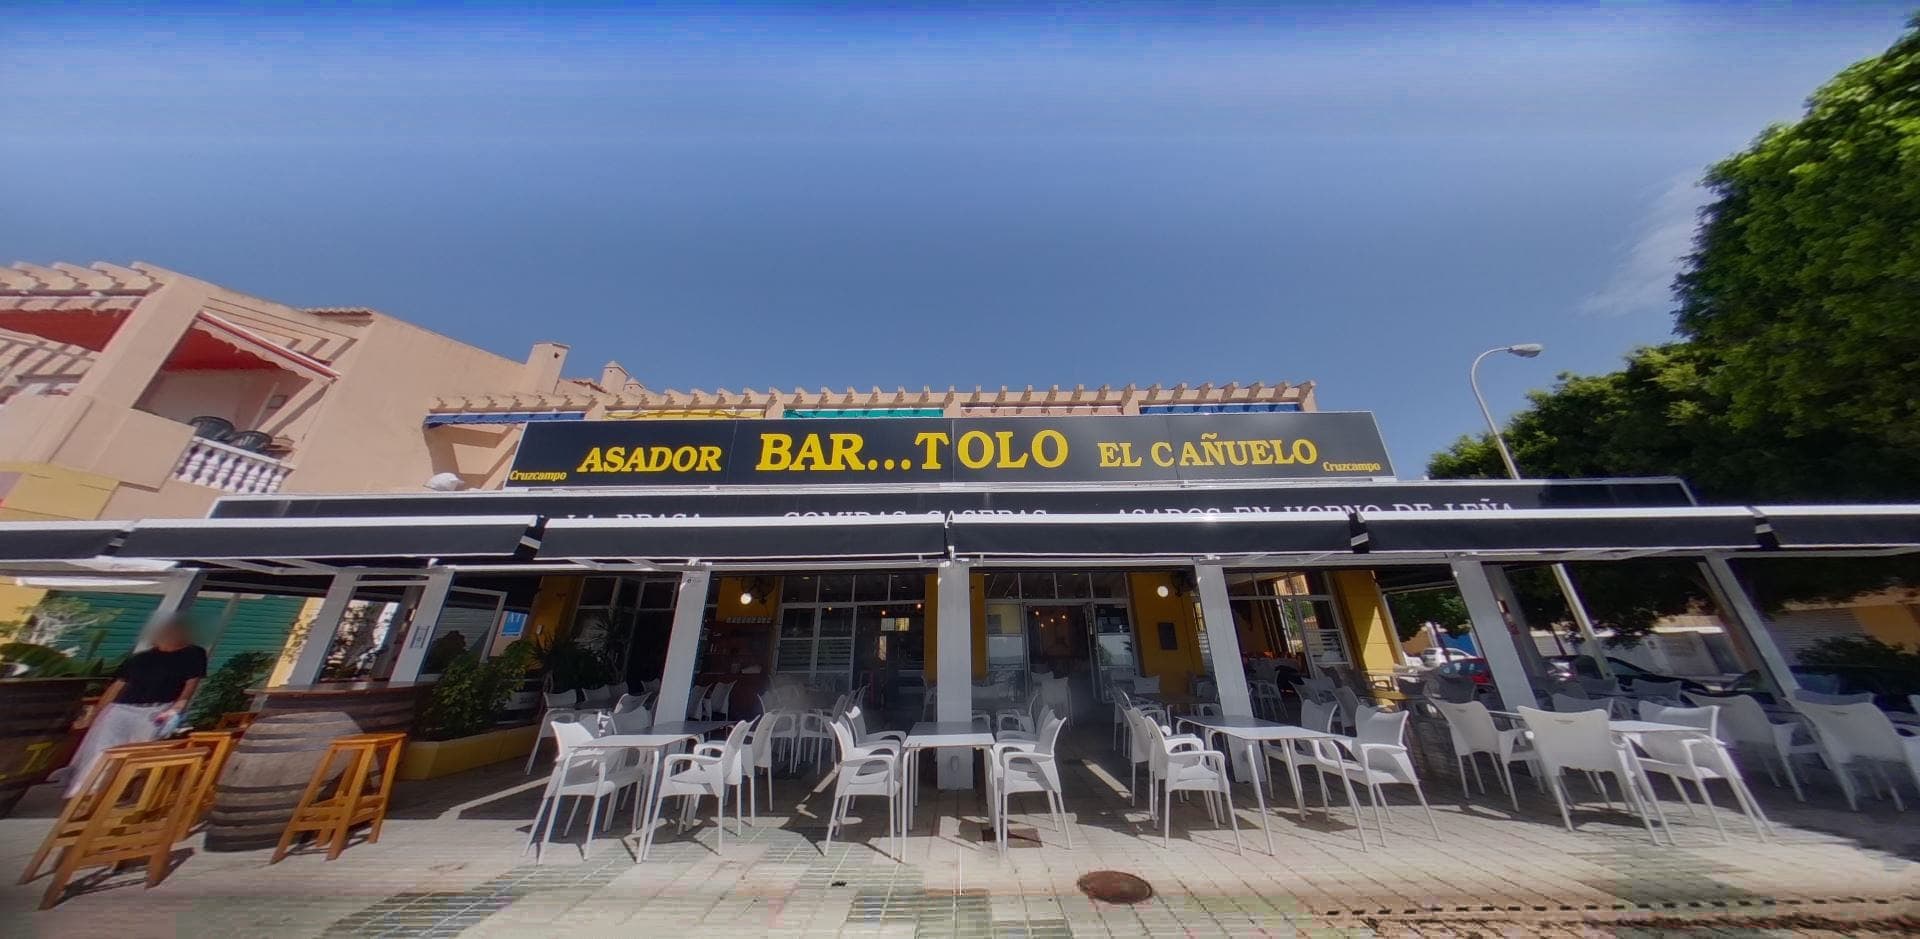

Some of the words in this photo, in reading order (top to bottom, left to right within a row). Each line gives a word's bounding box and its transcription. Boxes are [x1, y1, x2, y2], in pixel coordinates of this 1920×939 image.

[576, 446, 722, 473] ASADOR
[1097, 442, 1143, 467] EL
[1150, 432, 1319, 467] CAÑUELO
[1323, 461, 1381, 472] Cruzcampo
[509, 470, 568, 481] Cruzcampo
